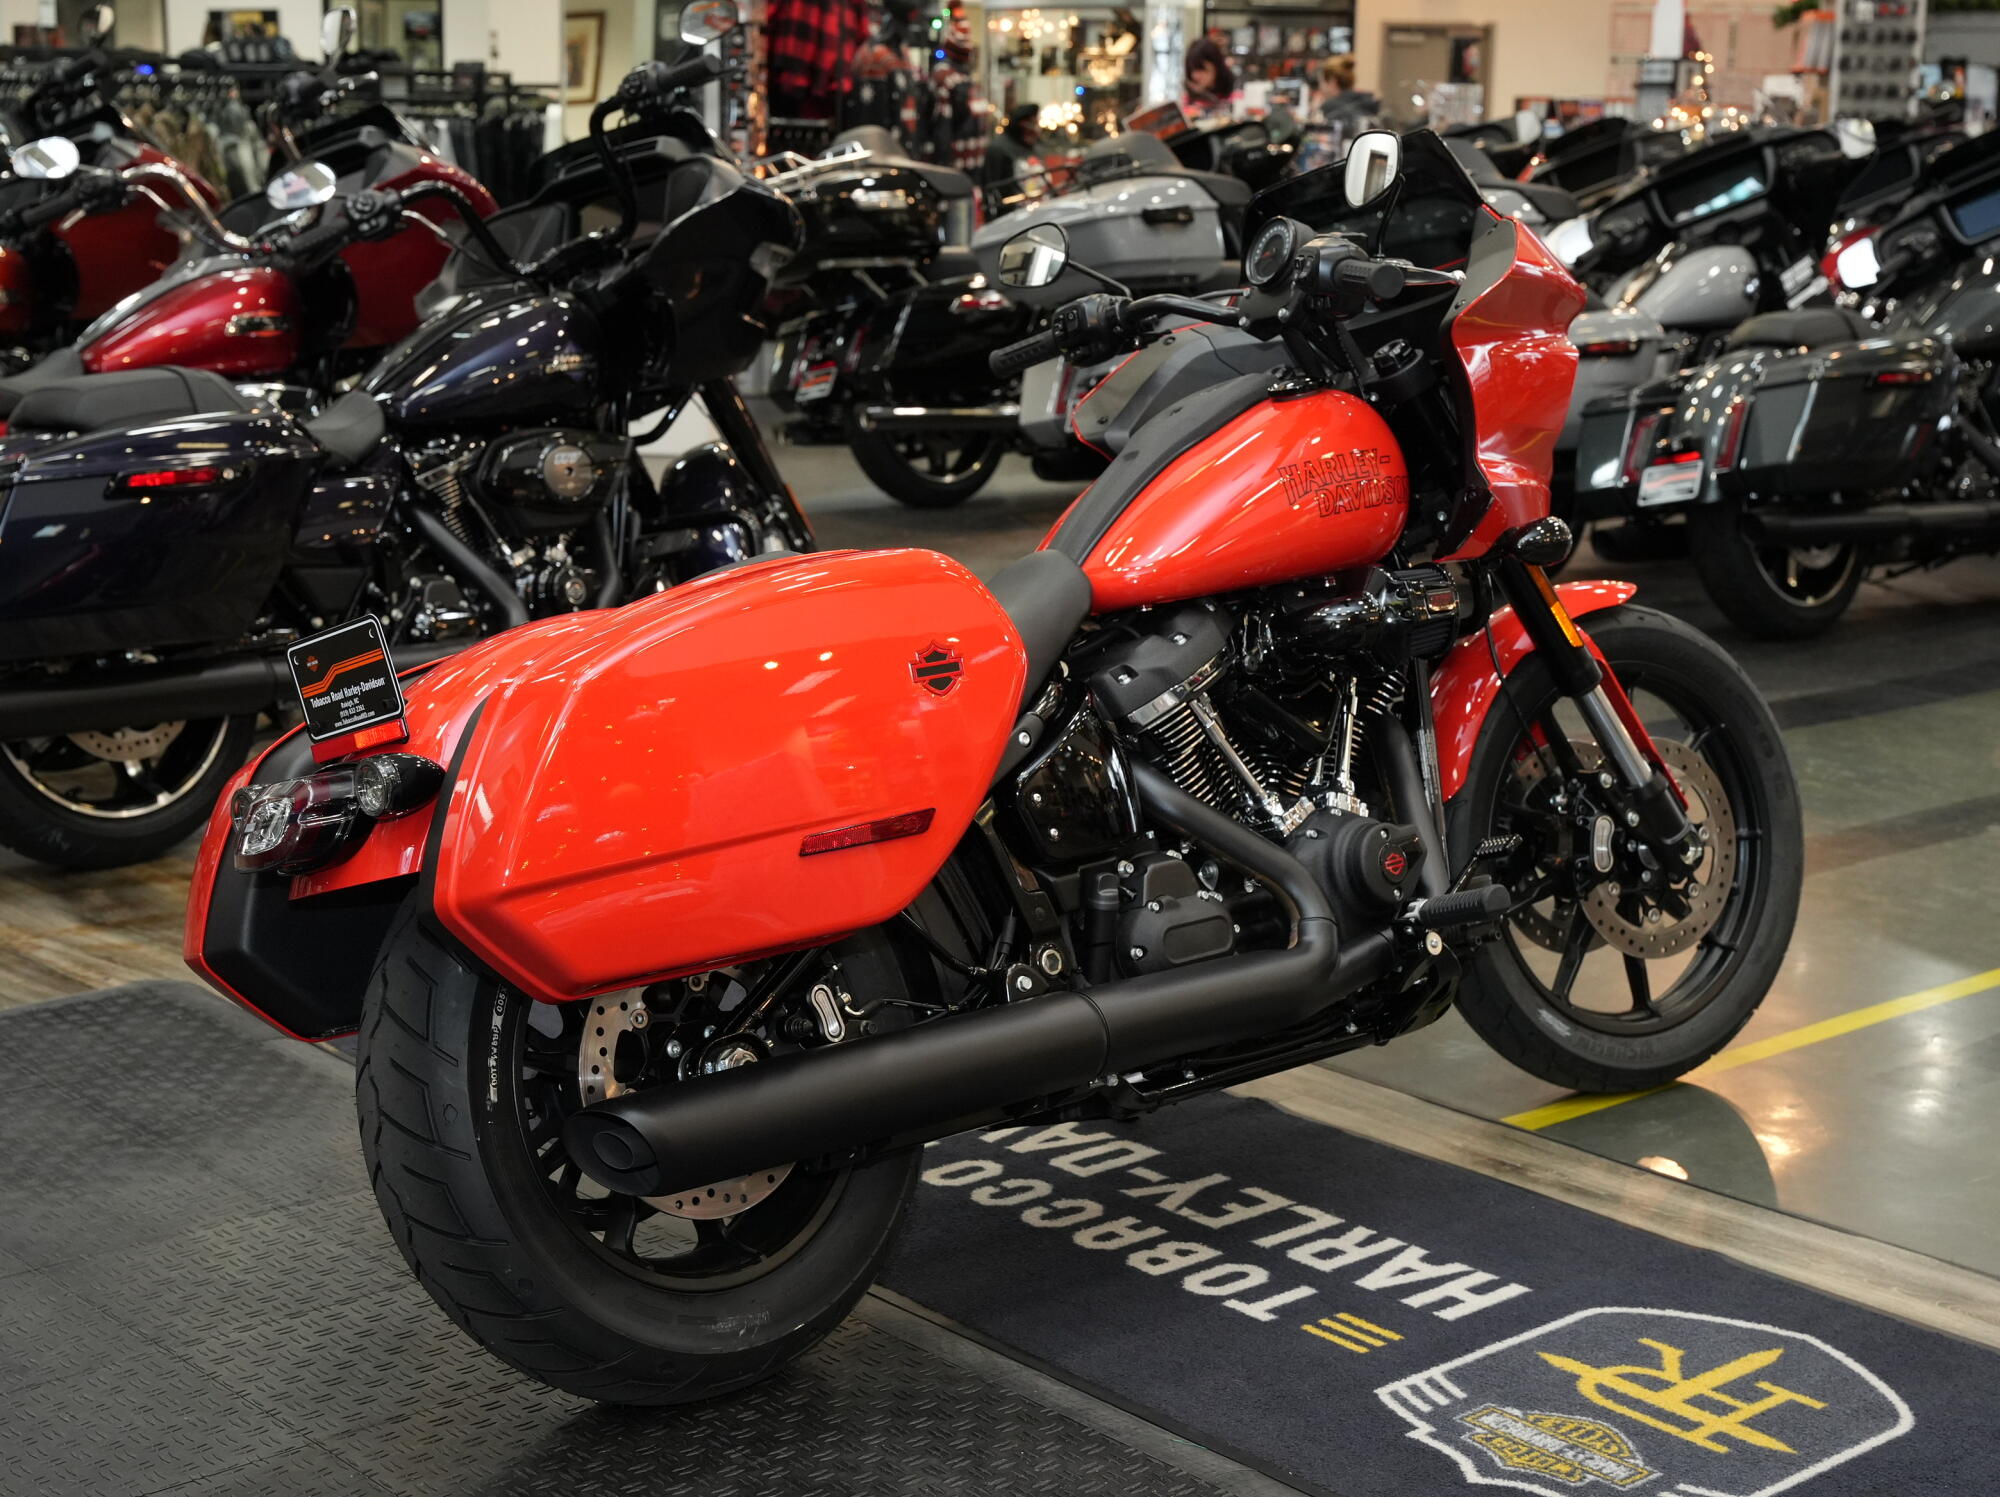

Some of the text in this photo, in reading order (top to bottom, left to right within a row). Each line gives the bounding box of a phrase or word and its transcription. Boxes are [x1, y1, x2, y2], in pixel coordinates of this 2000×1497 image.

[1277, 448, 1391, 506] HARLEY-
[310, 677, 385, 708] Tobacco Road Harley-Davidson
[921, 1159, 1318, 1321] TOBACCO
